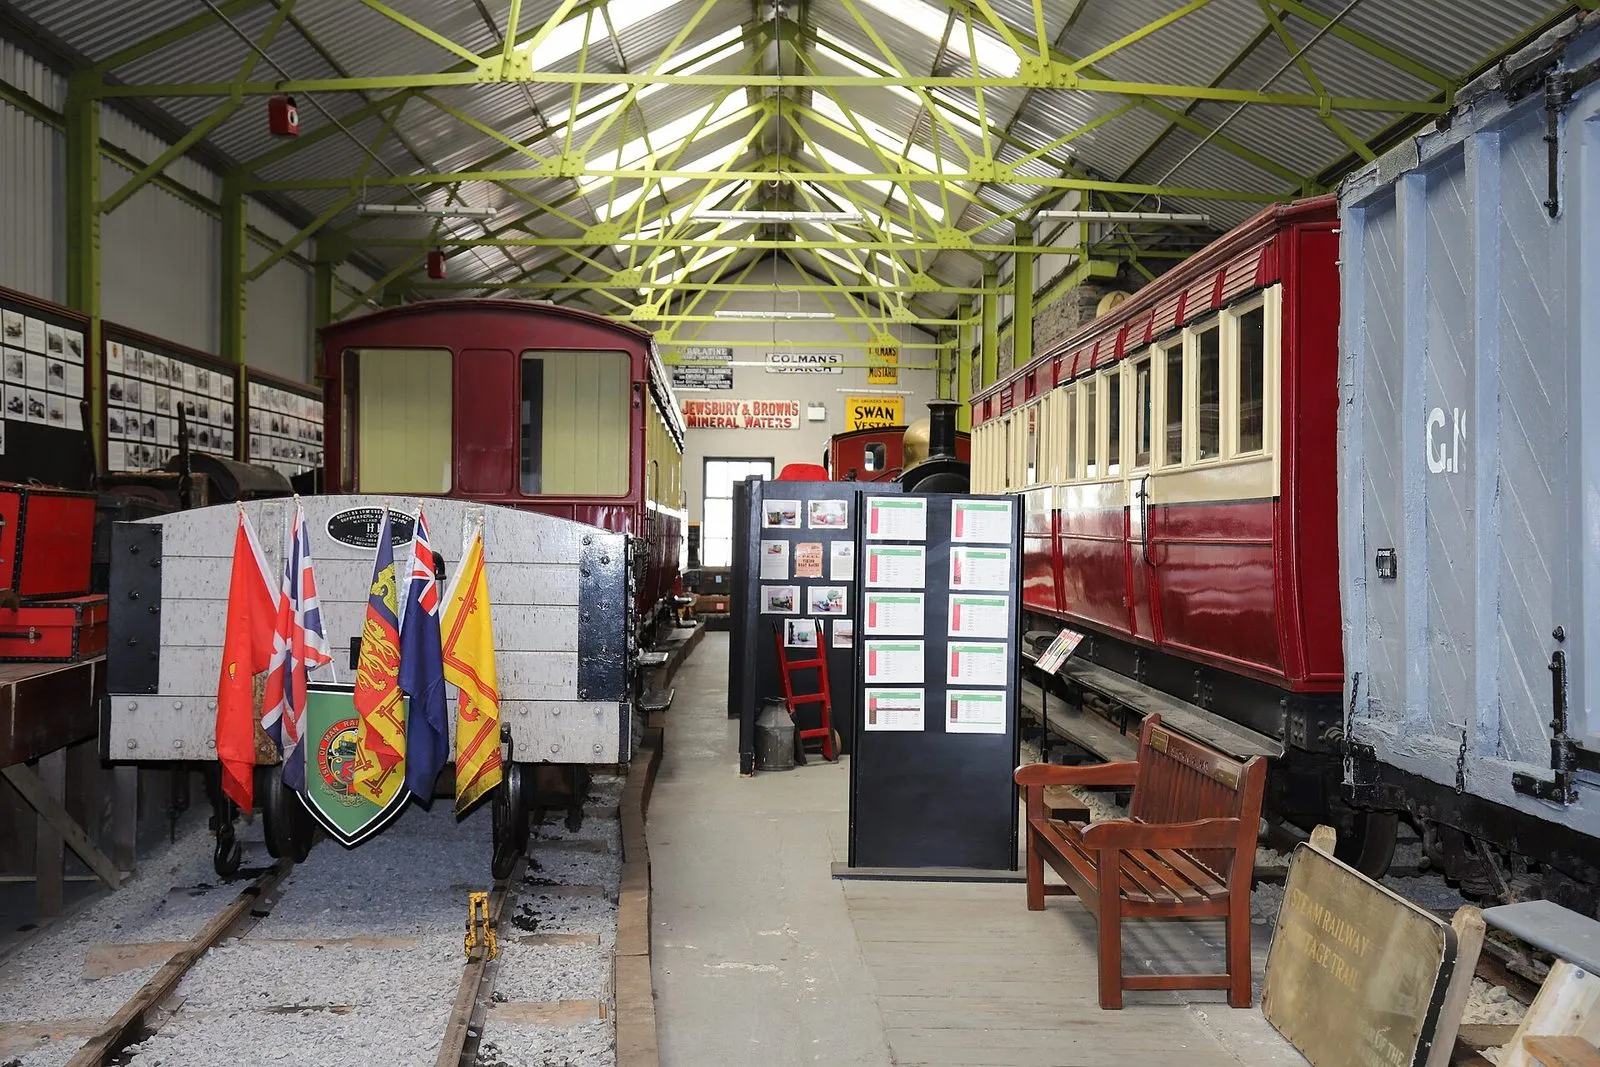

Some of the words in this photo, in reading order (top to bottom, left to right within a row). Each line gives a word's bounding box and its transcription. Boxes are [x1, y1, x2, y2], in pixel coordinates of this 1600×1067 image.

[681, 400, 740, 415] JEWSBURY
[741, 402, 751, 416] &
[854, 405, 895, 420] SWAN
[687, 415, 740, 428] MINERAL
[744, 416, 792, 428] WATERS
[324, 727, 340, 743] MAN
[1290, 887, 1324, 926] STEAM
[1322, 909, 1370, 958] RAILWAY
[1330, 952, 1360, 993] TRAIL
[1387, 1041, 1405, 1066] THE
